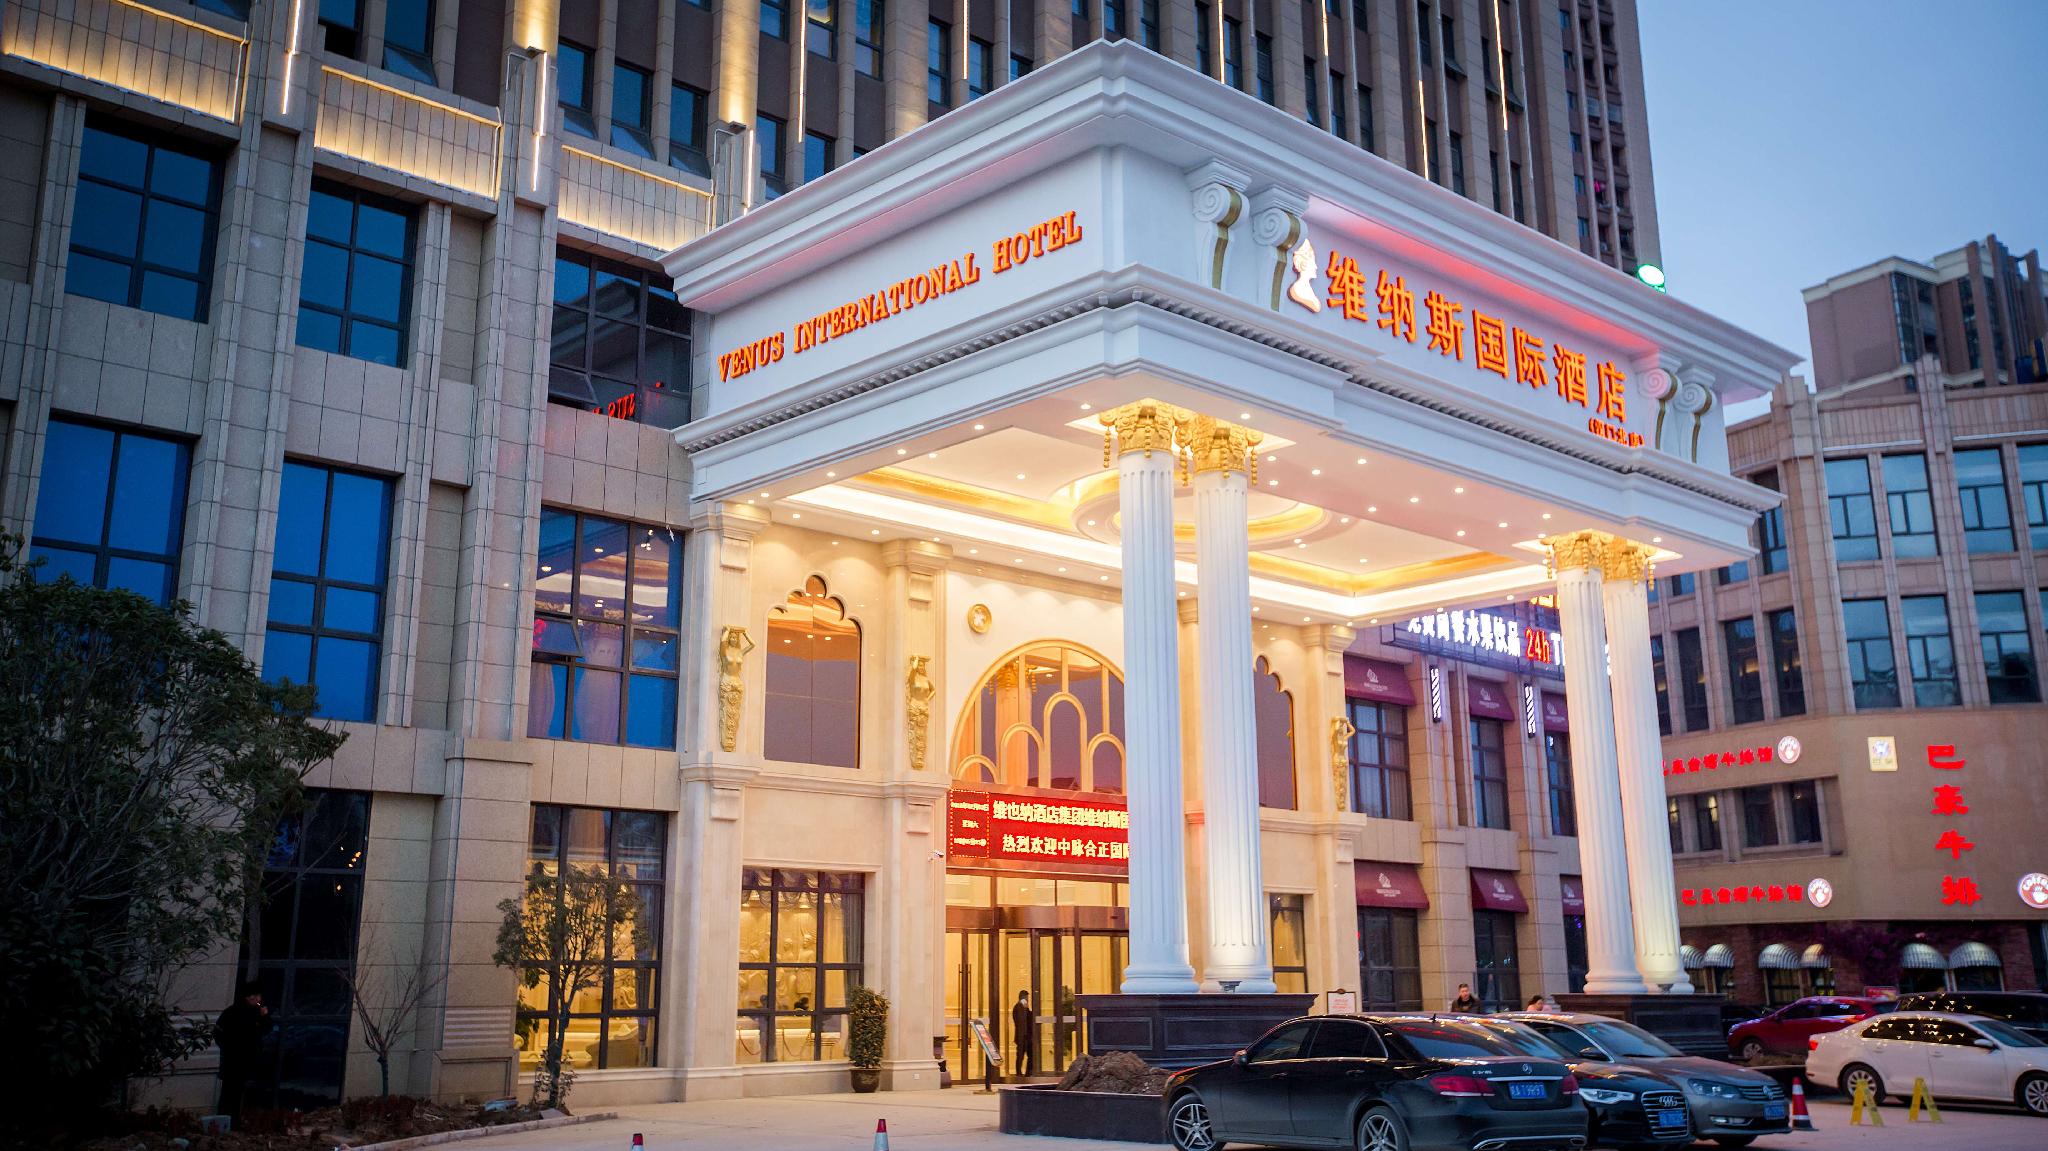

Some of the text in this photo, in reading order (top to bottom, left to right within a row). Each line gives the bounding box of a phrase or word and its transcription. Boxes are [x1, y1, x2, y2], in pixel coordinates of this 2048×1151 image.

[717, 209, 1084, 382] VENUS INTERNATIONAL HOTEL
[1326, 250, 1628, 424] 维纳斯国际酒店
